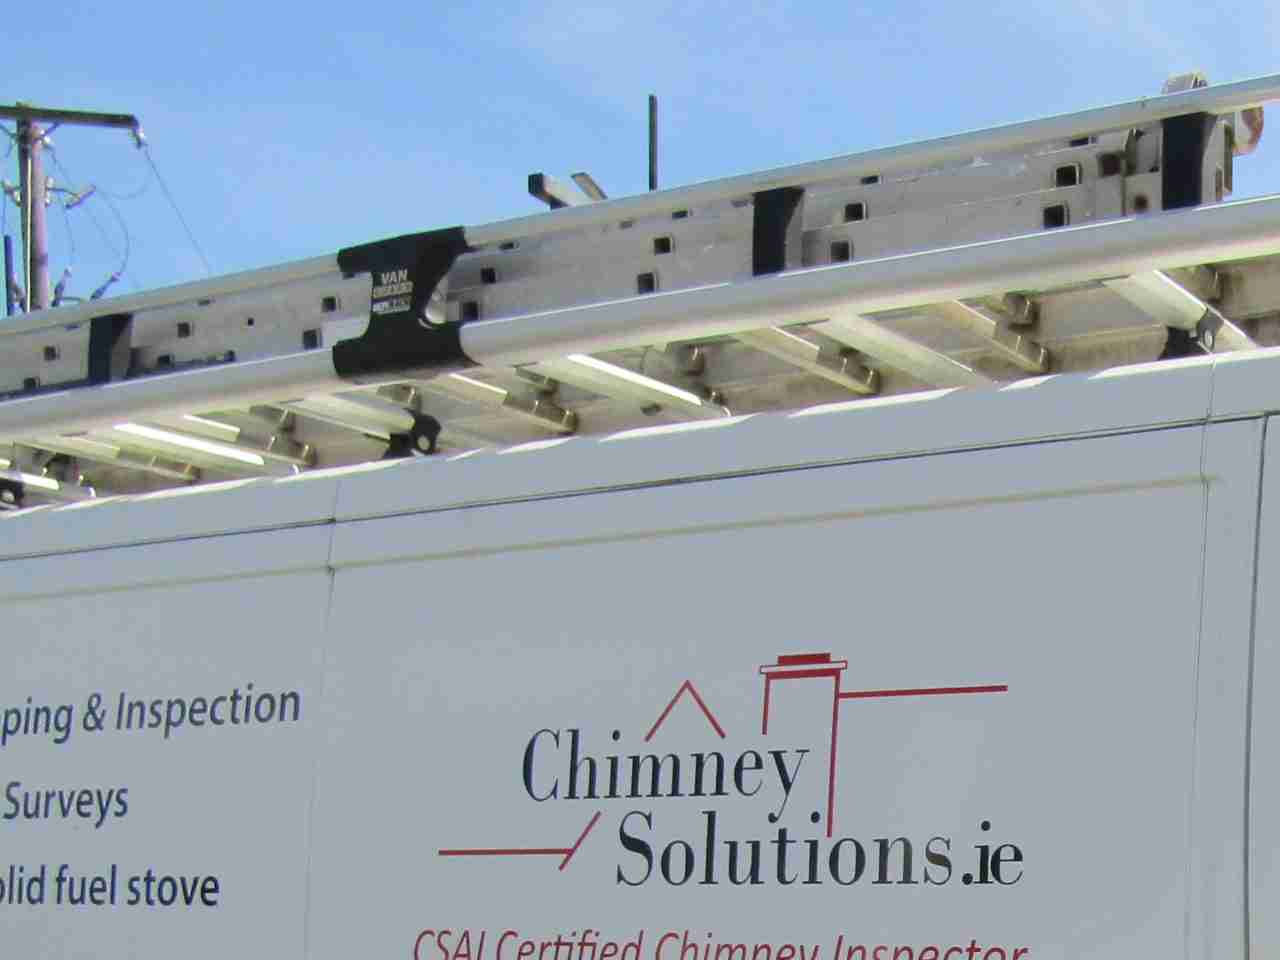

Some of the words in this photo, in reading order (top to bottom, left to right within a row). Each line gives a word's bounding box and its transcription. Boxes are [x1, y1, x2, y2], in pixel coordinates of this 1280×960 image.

[381, 269, 408, 285] VAN
[82, 692, 107, 732] &
[116, 683, 301, 740] Inspection
[521, 728, 810, 824] Chimney
[2, 780, 129, 830] Surveys
[616, 810, 1024, 887] Solutions.ie
[55, 864, 117, 906] fuel
[126, 869, 220, 907] stove
